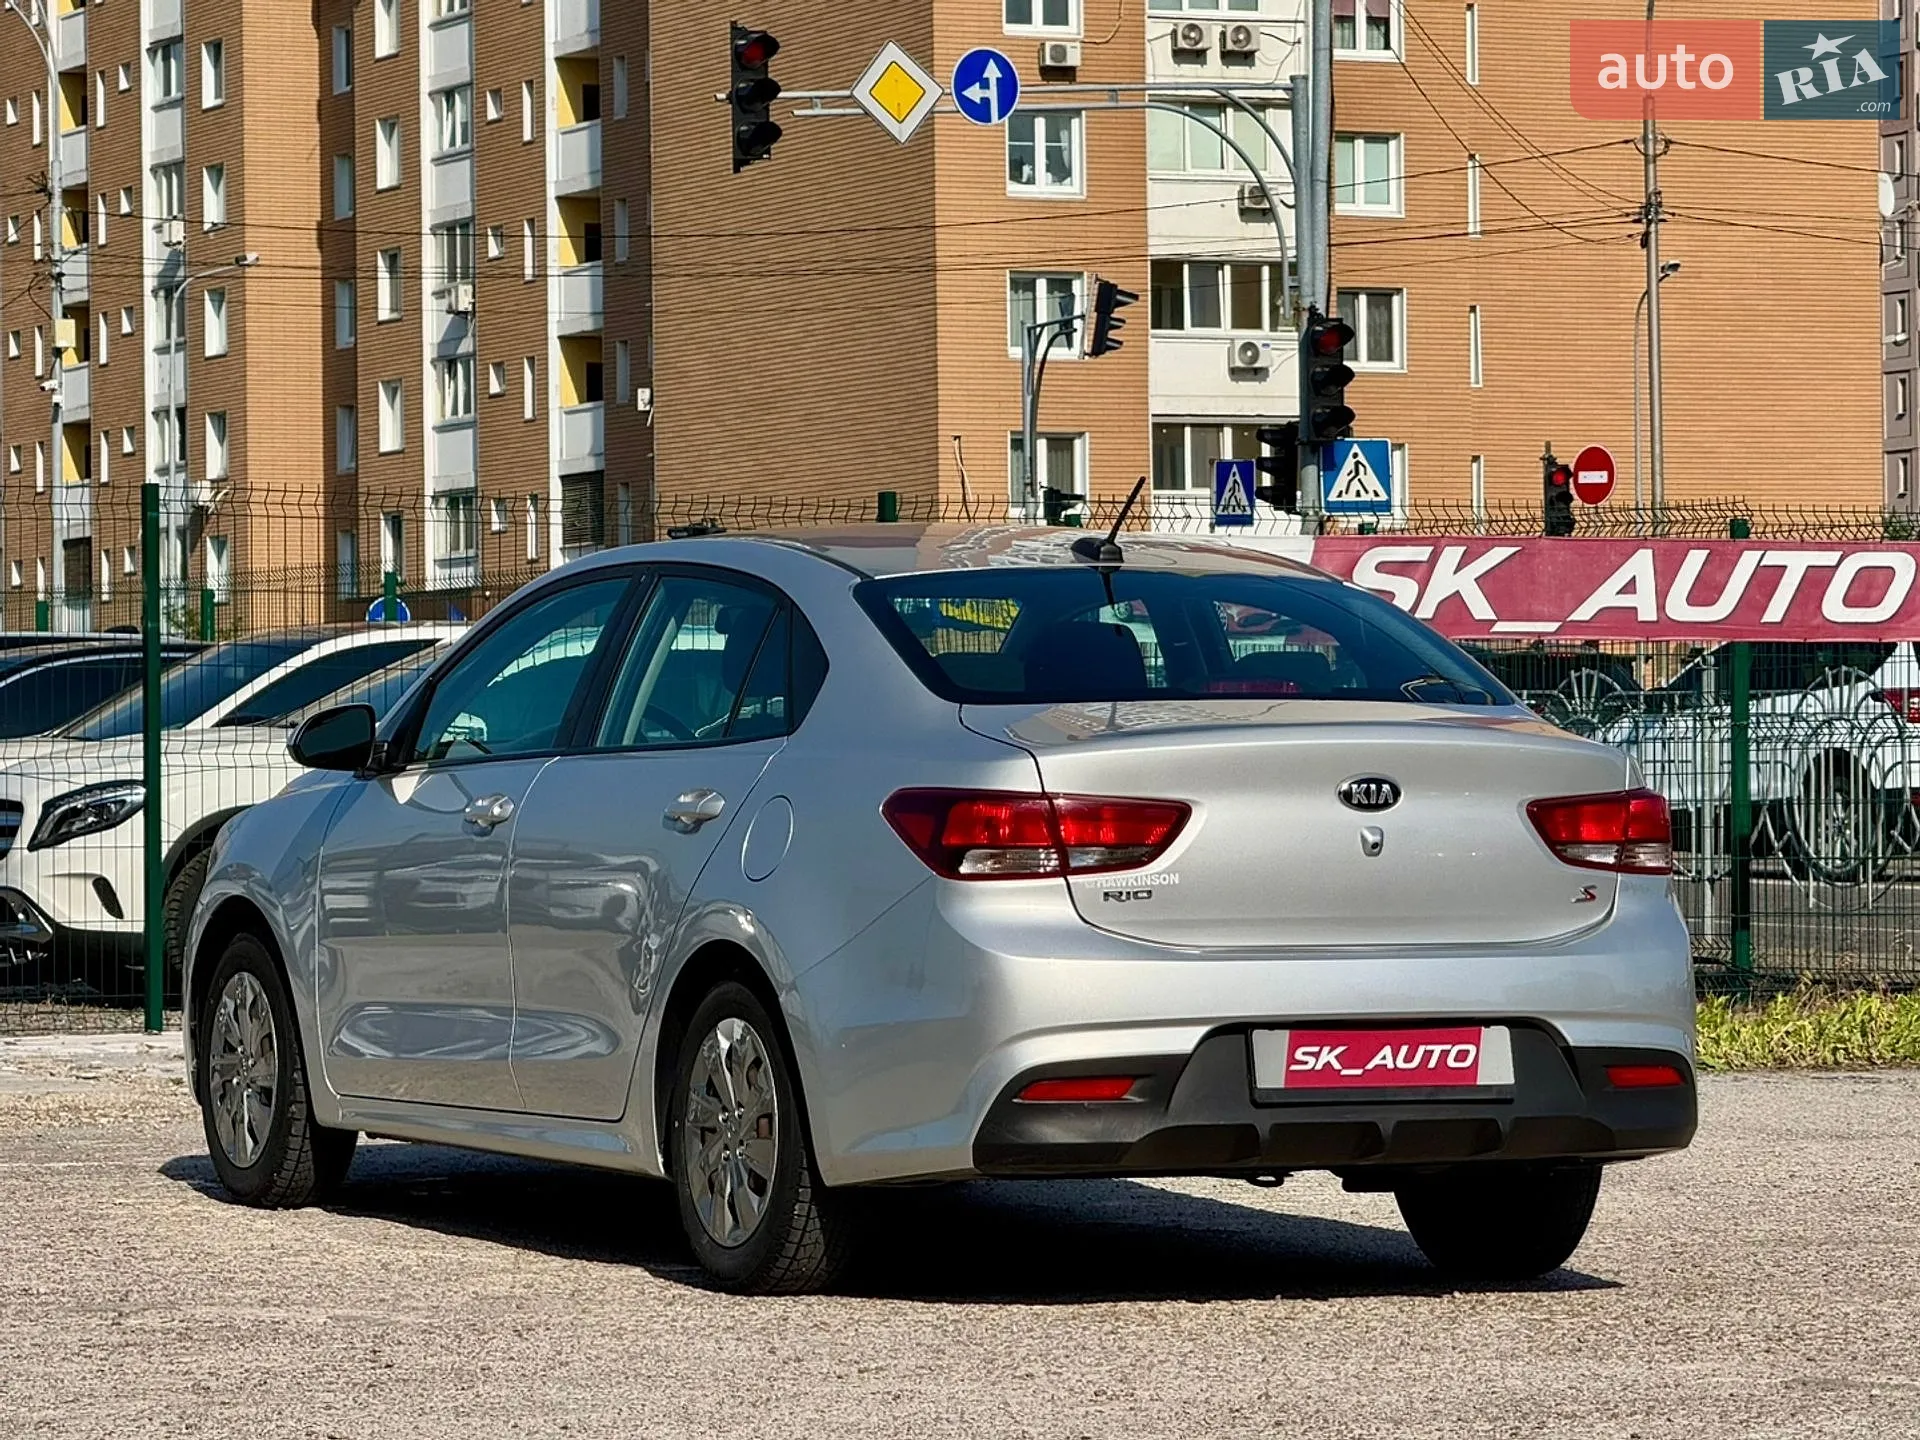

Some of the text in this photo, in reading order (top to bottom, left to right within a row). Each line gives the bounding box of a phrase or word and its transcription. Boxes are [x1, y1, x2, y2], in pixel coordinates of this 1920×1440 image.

[1351, 783, 1394, 804] KIA
[1097, 872, 1180, 888] HAWKINSON
[1102, 889, 1152, 902] RIO
[1289, 1044, 1477, 1075] SK_AUTO
